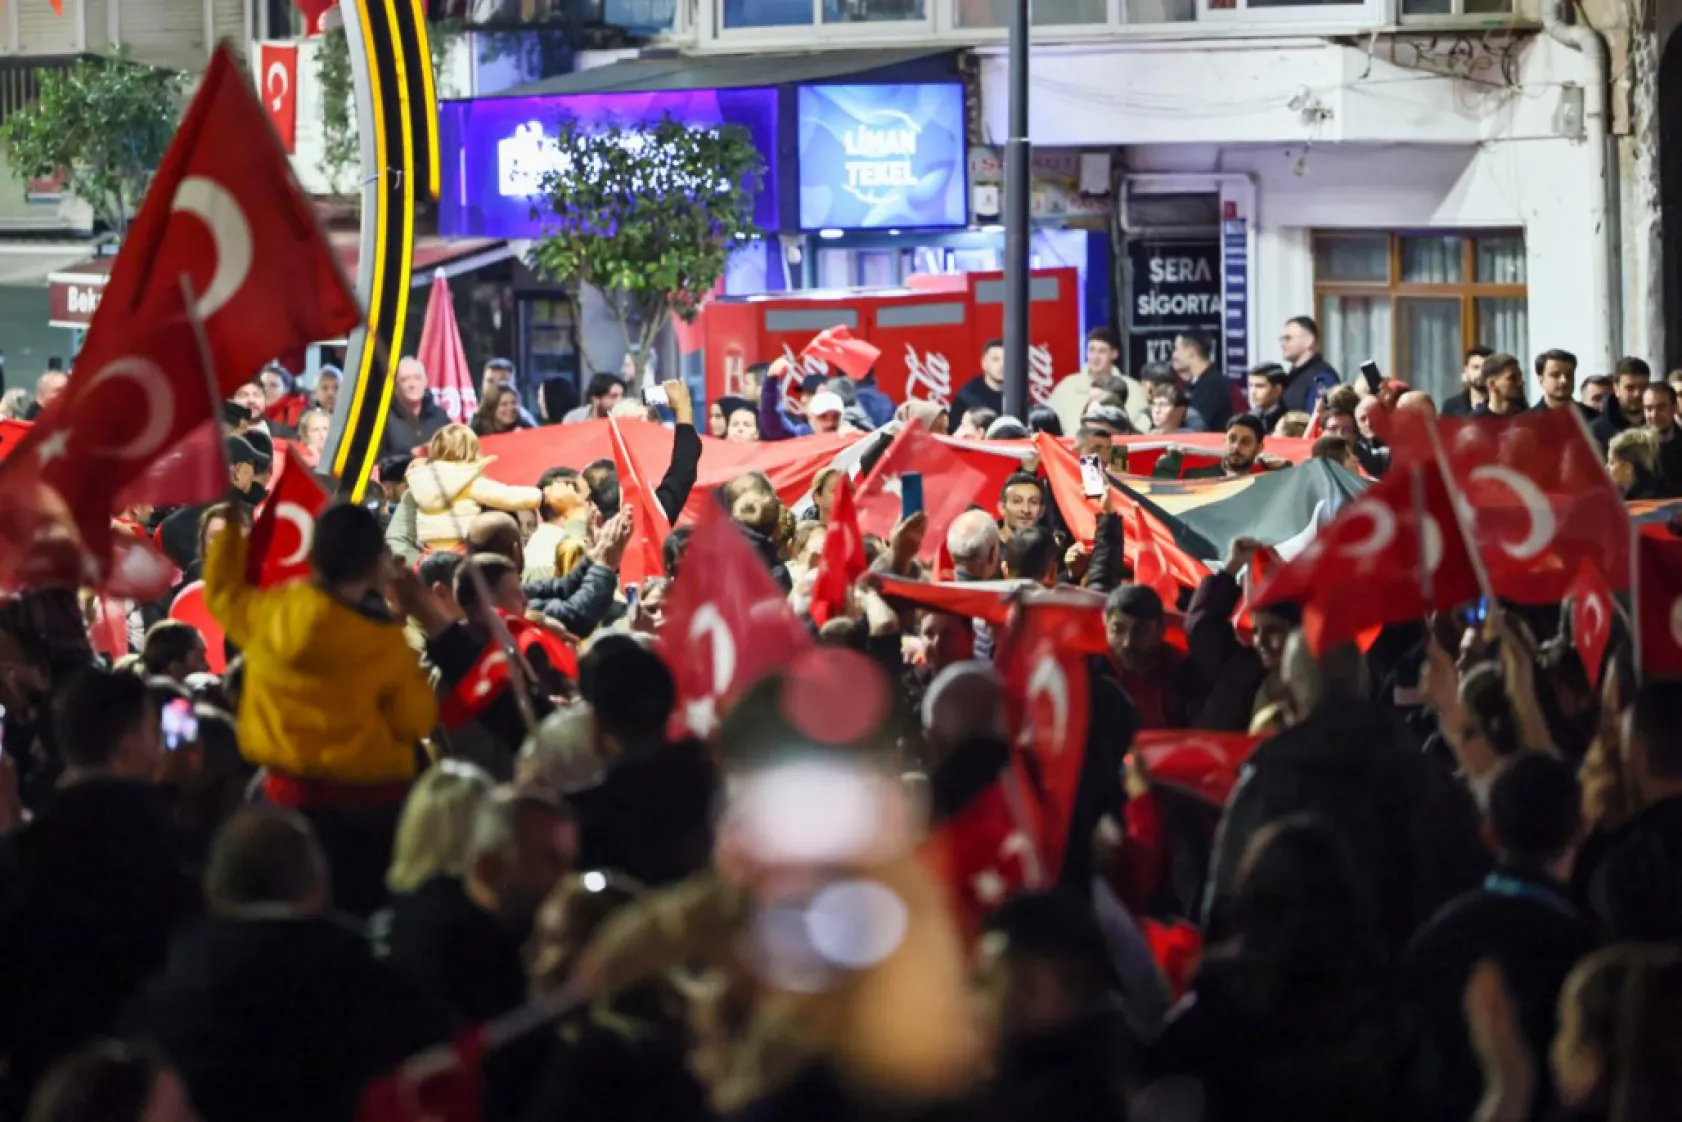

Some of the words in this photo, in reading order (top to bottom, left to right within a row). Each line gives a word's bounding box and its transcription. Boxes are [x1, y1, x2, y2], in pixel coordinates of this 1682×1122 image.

[844, 161, 919, 187] TEKEL
[1150, 257, 1212, 282] SERA
[1138, 289, 1221, 315] SİGORTA
